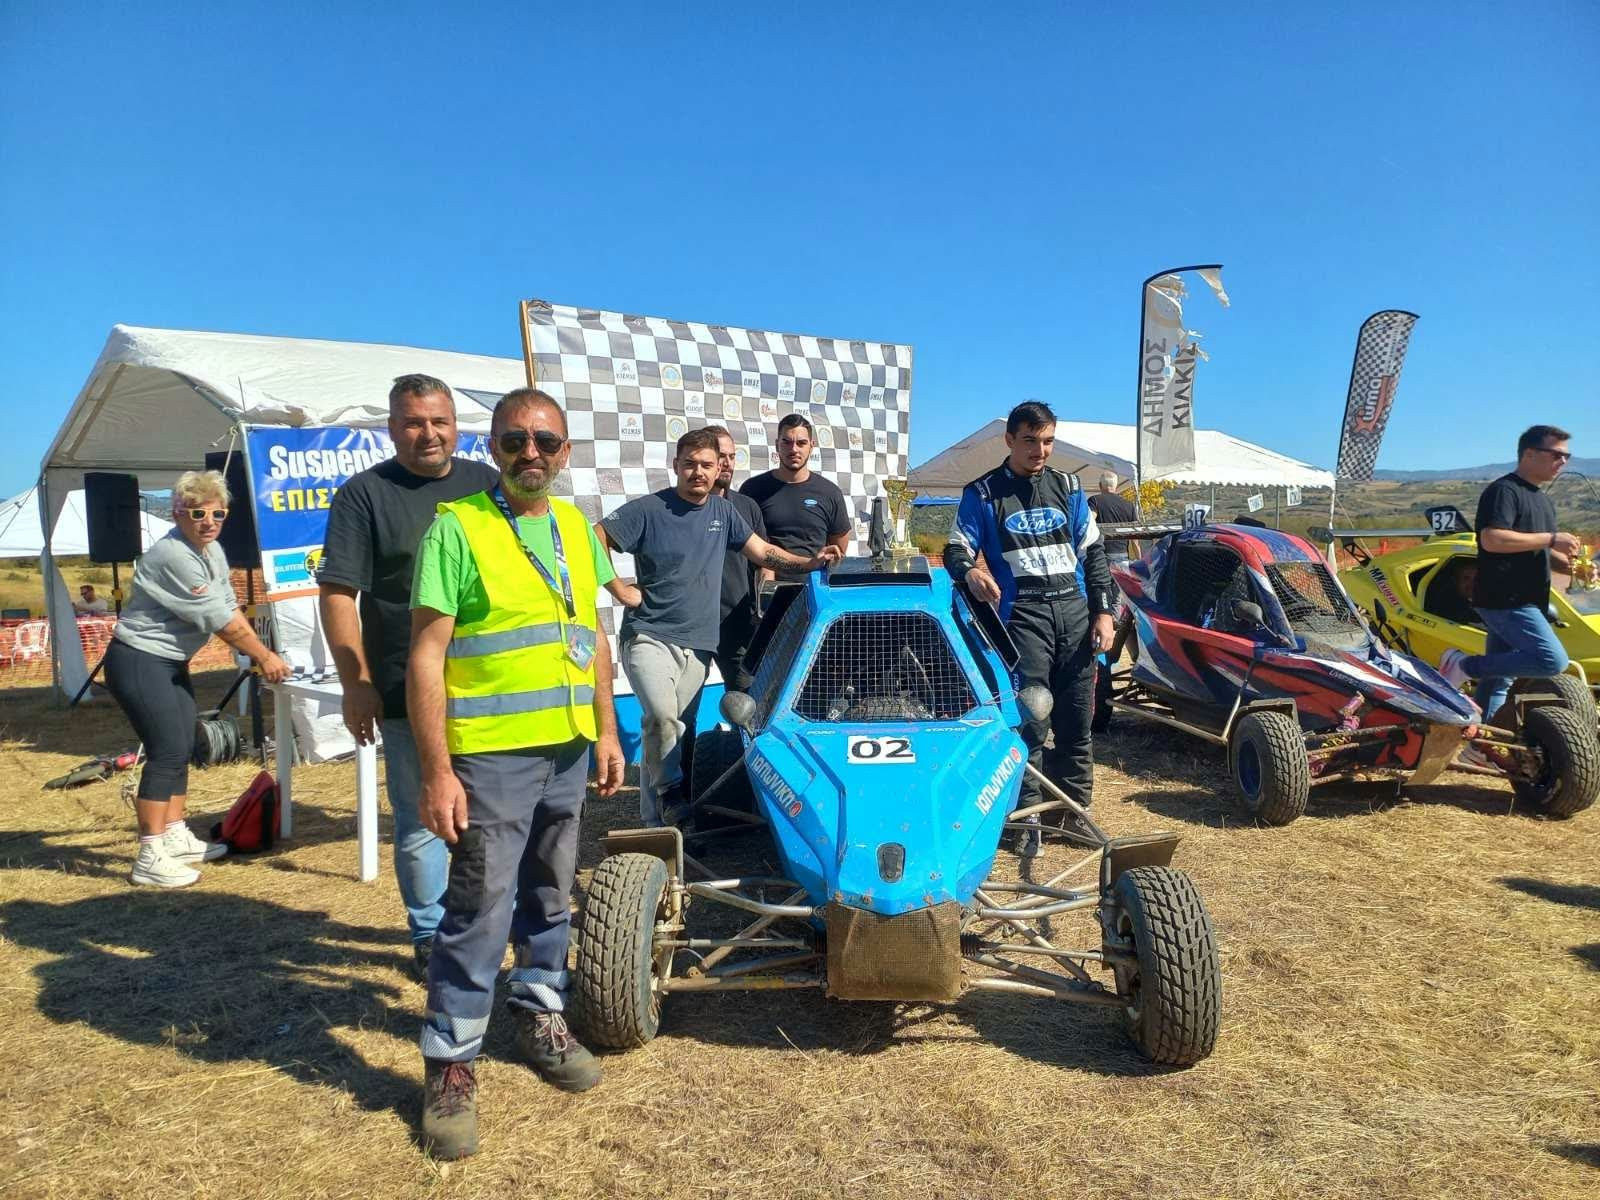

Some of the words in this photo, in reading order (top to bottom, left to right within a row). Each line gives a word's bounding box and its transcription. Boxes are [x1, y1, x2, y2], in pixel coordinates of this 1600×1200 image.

[1143, 337, 1167, 438] ΔΗΜΟΣ
[1017, 512, 1057, 530] Ford
[1432, 512, 1457, 531] 32
[851, 739, 914, 759] 02
